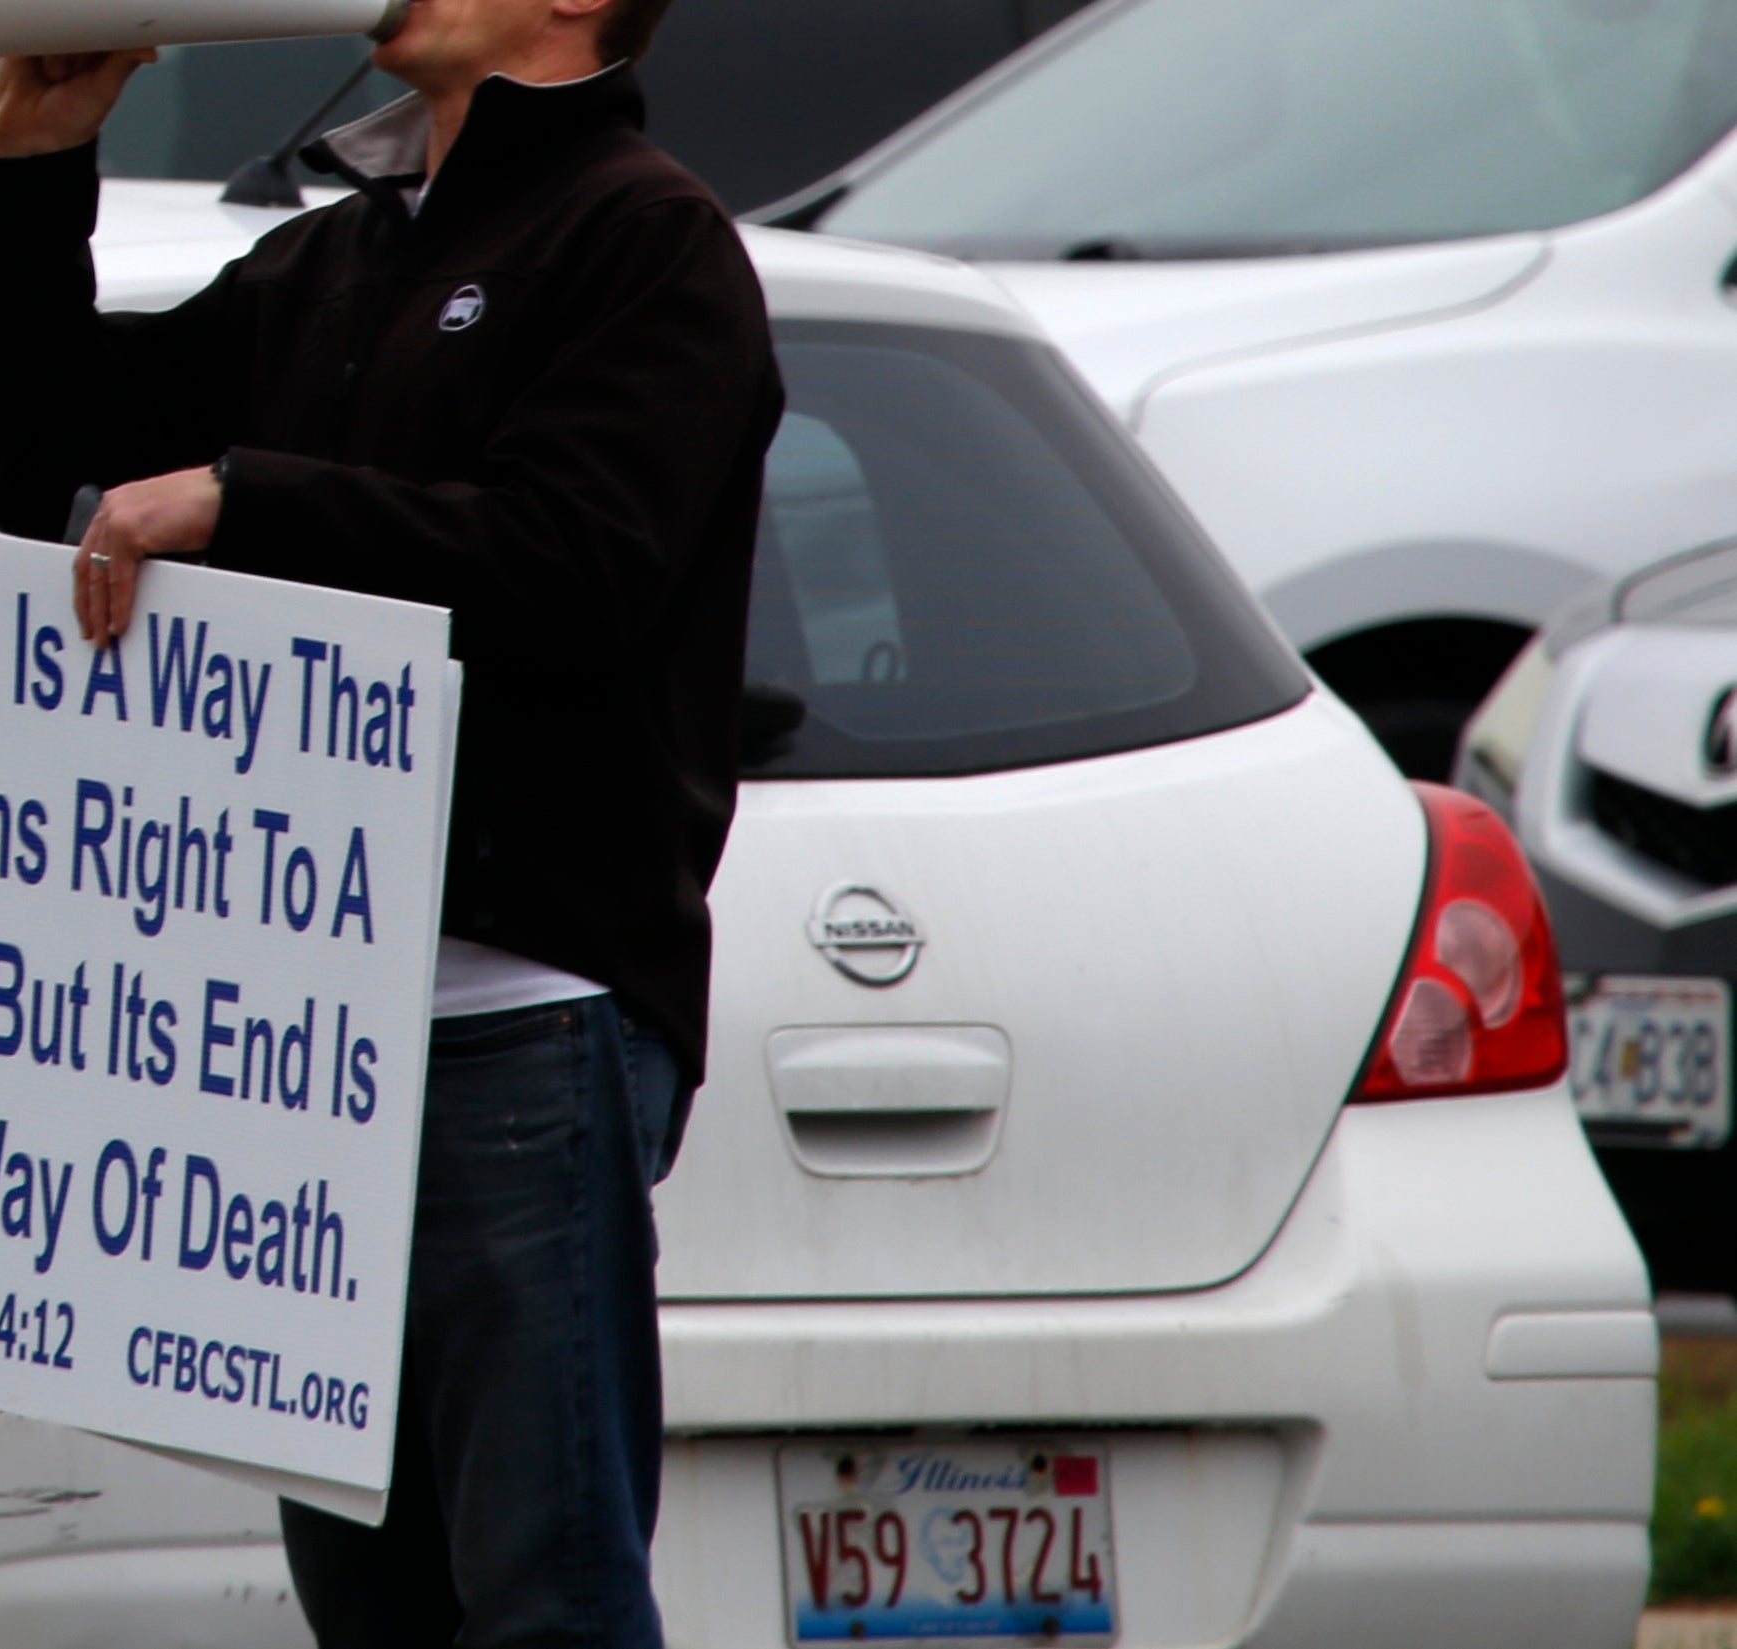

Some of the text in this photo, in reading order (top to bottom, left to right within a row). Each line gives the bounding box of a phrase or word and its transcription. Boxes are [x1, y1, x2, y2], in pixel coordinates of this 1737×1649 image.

[14, 592, 64, 710] Is
[81, 639, 127, 721] A
[147, 612, 272, 774] Way
[291, 636, 415, 773] That
[71, 778, 233, 936] Right
[252, 808, 317, 932] To
[330, 826, 373, 943] A
[823, 919, 916, 938] NISSAN
[107, 962, 177, 1085] Its
[199, 978, 315, 1109] End
[331, 1003, 377, 1123] Is
[92, 1138, 167, 1260] Of
[178, 1153, 357, 1300] Death.
[896, 1453, 1028, 1493] Illinois
[798, 1506, 1103, 1612] V59 3724
